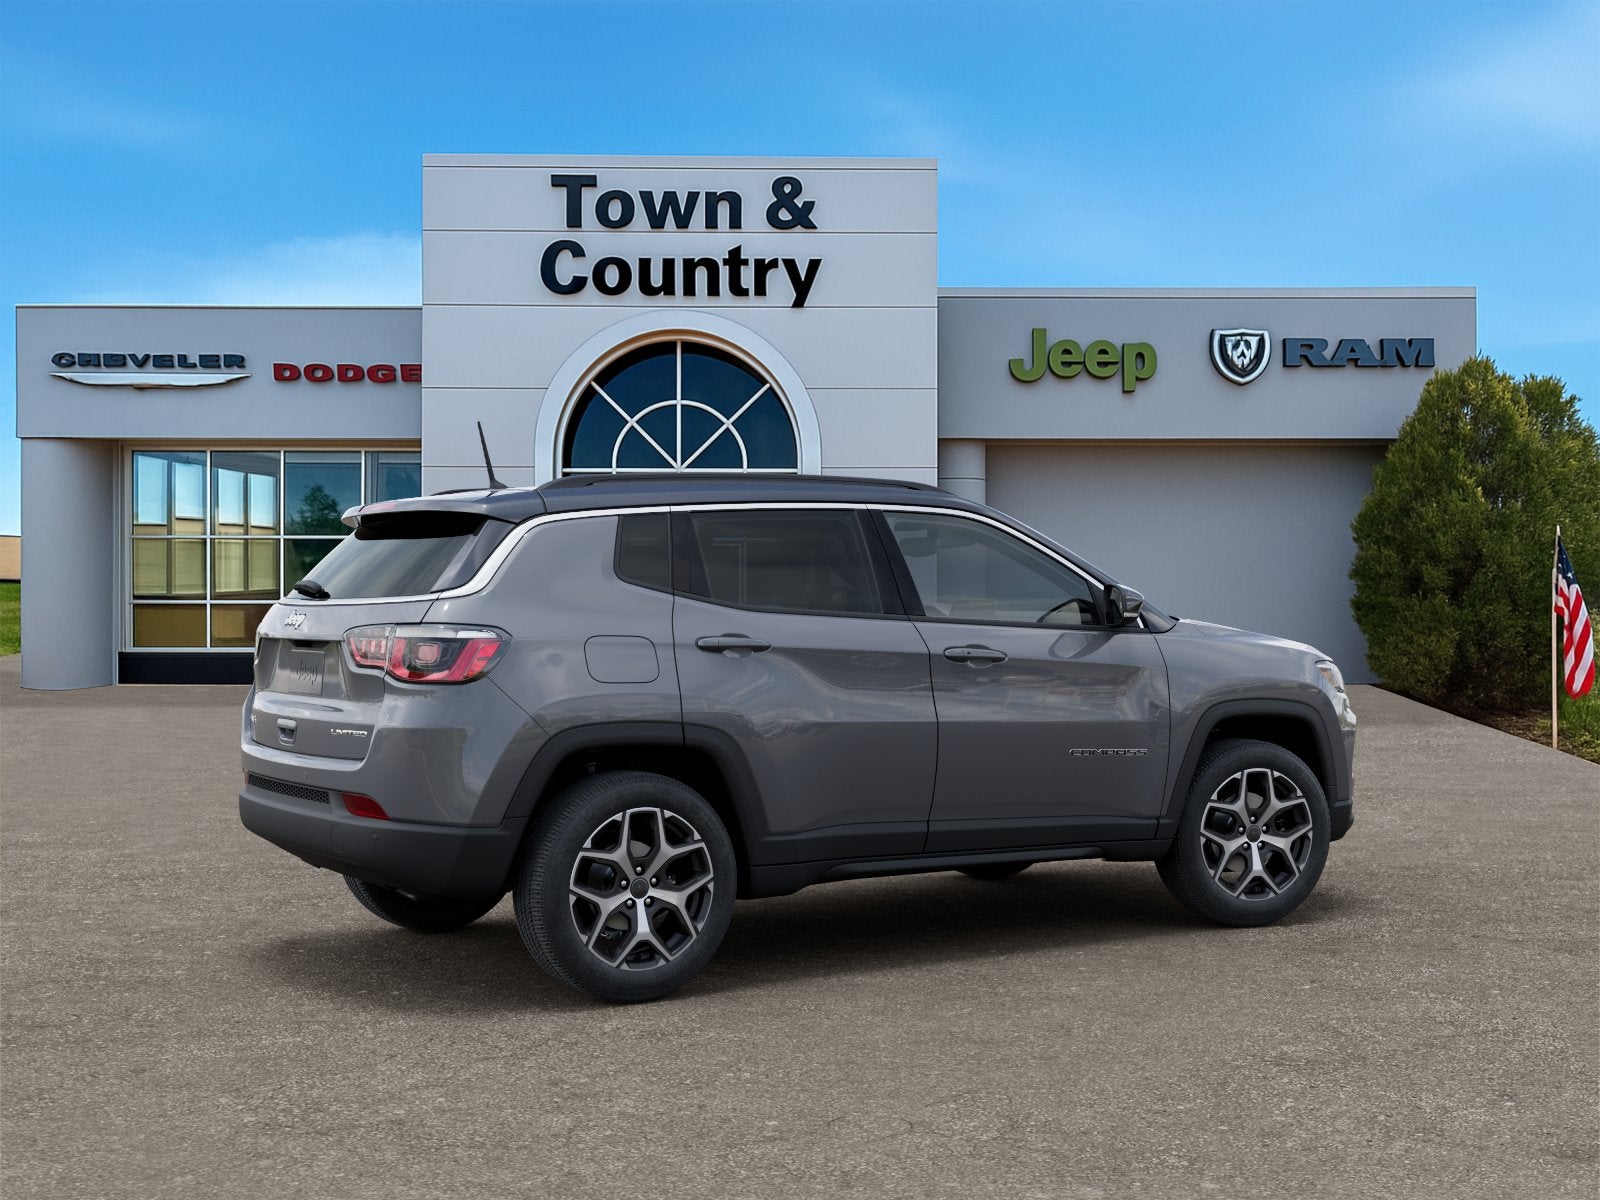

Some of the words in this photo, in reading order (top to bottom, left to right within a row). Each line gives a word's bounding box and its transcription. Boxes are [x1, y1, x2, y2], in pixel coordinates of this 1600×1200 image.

[550, 173, 742, 229] Town
[766, 175, 818, 229] &
[539, 239, 823, 308] Country
[273, 363, 422, 383] DODGE
[1008, 327, 1157, 393] Jeep
[1282, 337, 1435, 368] RAM
[1069, 748, 1148, 756] COMPASS
